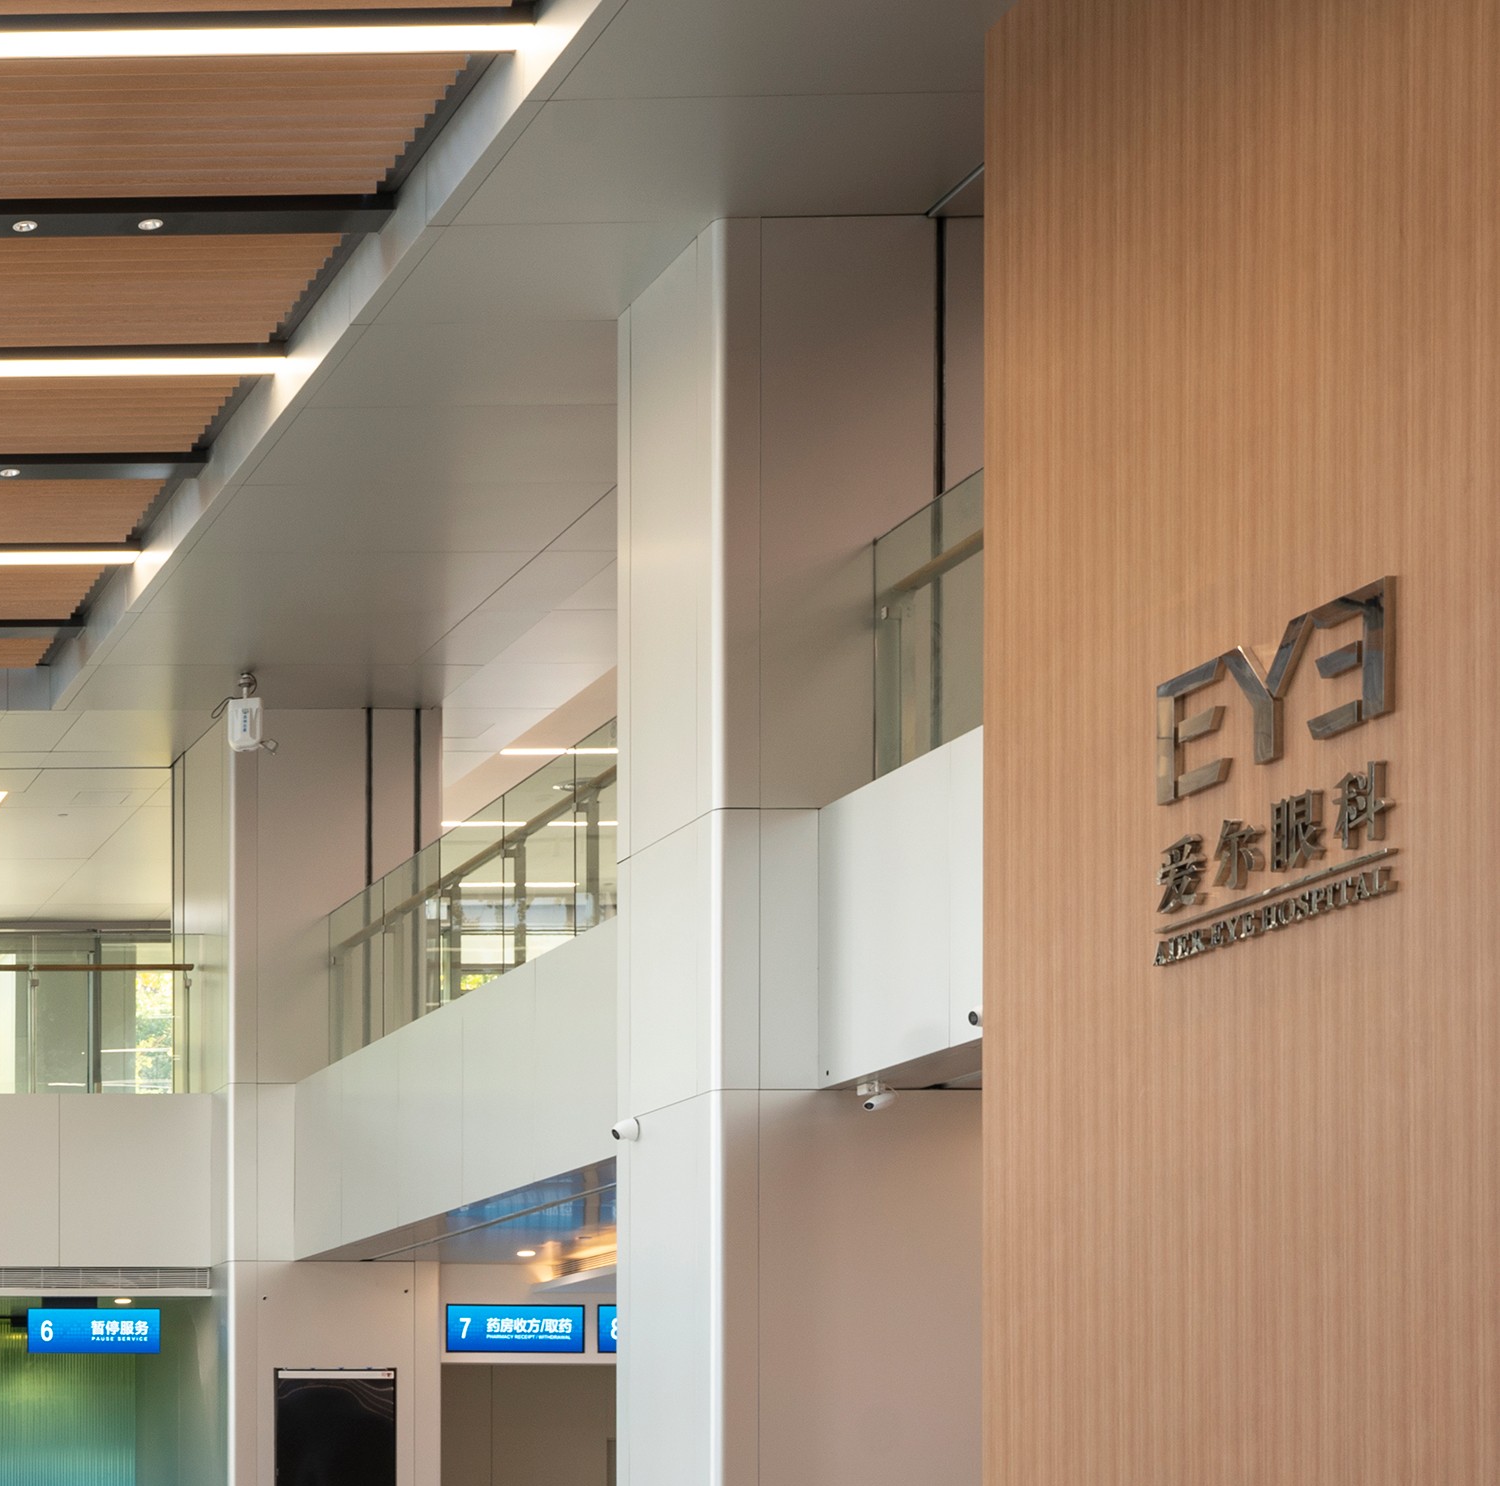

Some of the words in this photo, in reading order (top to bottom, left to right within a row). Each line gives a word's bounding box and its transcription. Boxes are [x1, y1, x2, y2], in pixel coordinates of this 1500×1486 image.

[1156, 760, 1397, 914] 爱尔眼科
[1153, 928, 1205, 966] AIER
[1210, 911, 1256, 947] EYE
[1261, 866, 1398, 932] HOSPITAL
[40, 1320, 53, 1341] 6
[91, 1320, 149, 1335] 暂停服务
[459, 1317, 471, 1339] 7
[486, 1317, 572, 1333] 药房收方/取药
